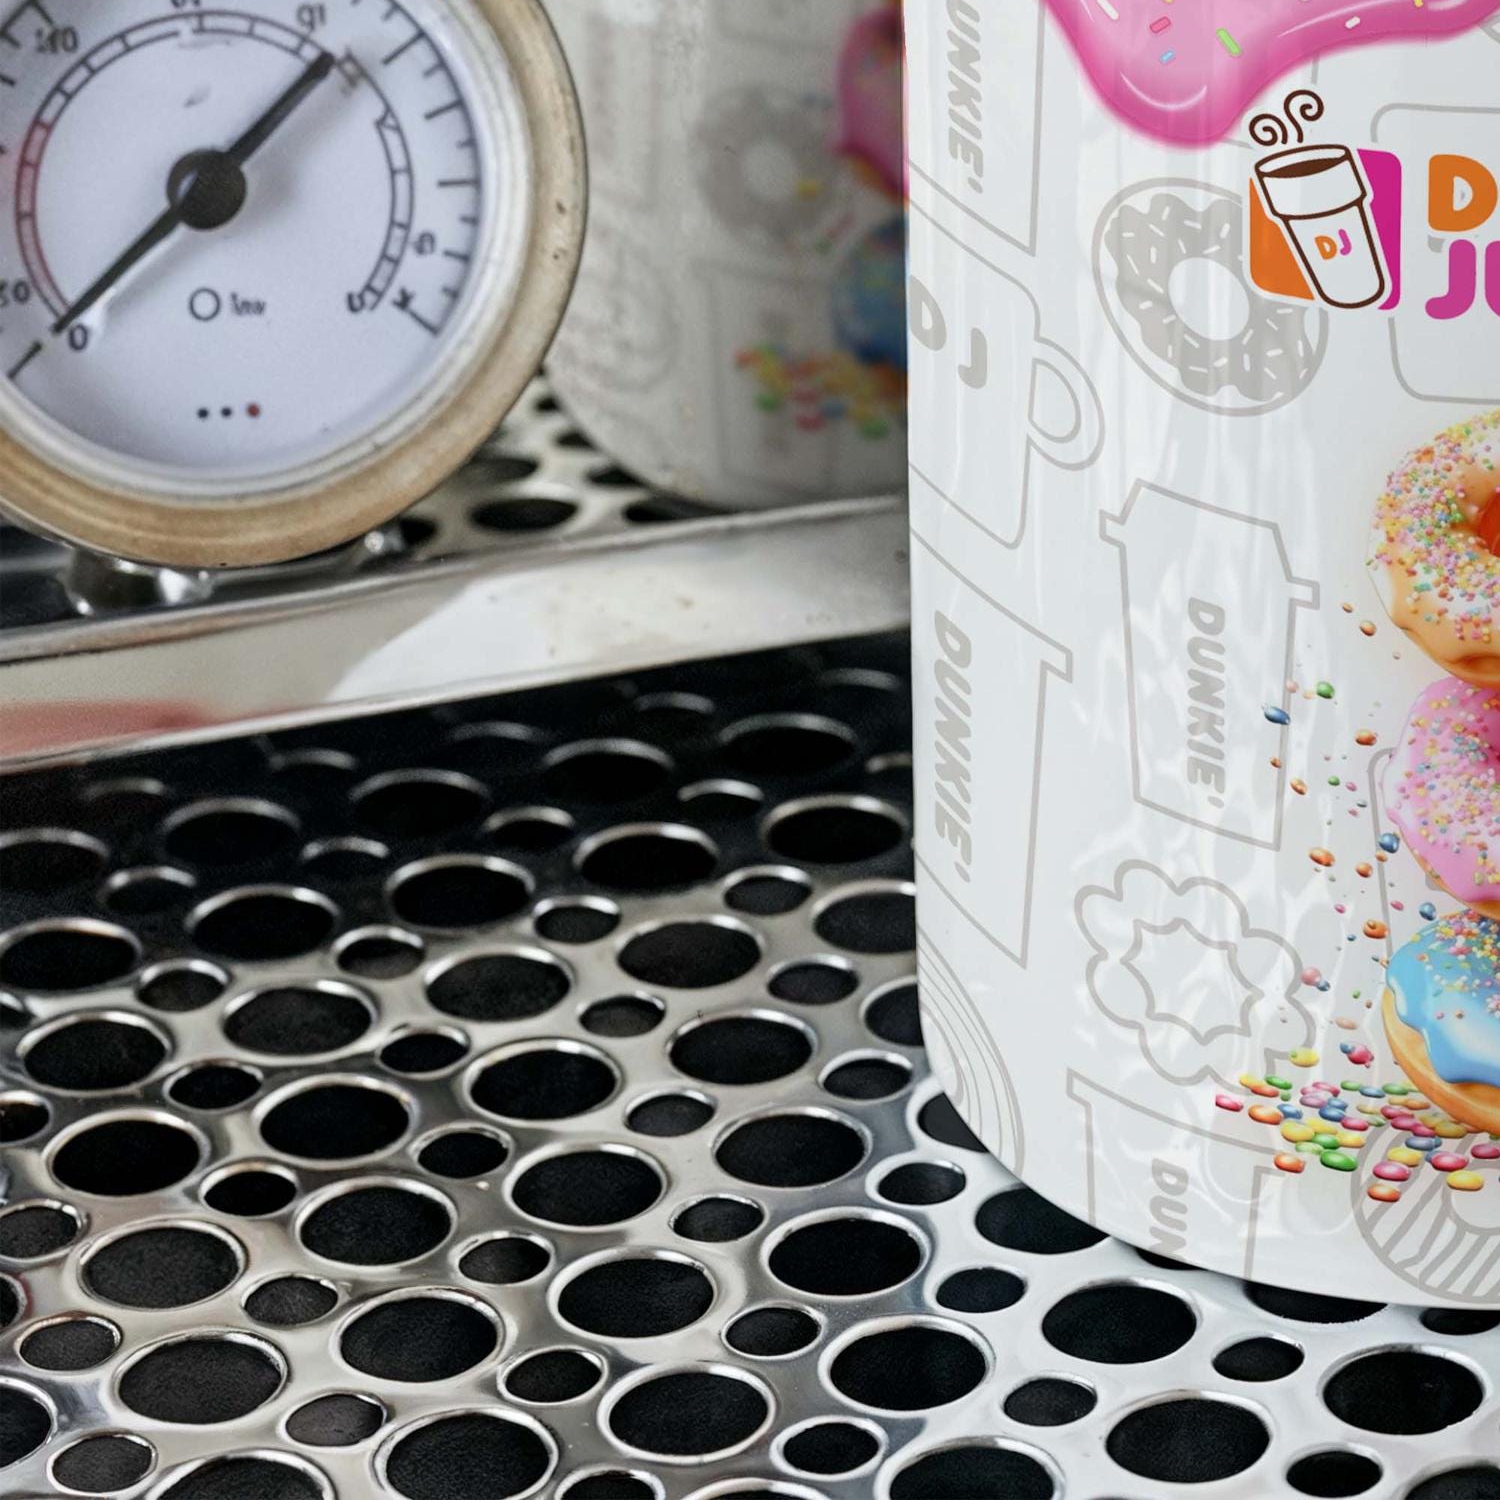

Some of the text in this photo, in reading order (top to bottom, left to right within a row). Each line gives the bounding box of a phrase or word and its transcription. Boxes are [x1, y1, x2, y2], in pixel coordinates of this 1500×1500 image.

[1314, 227, 1352, 262] DJ
[933, 608, 974, 885] DUNKIE'
[1186, 596, 1227, 811] DUNKIE'
